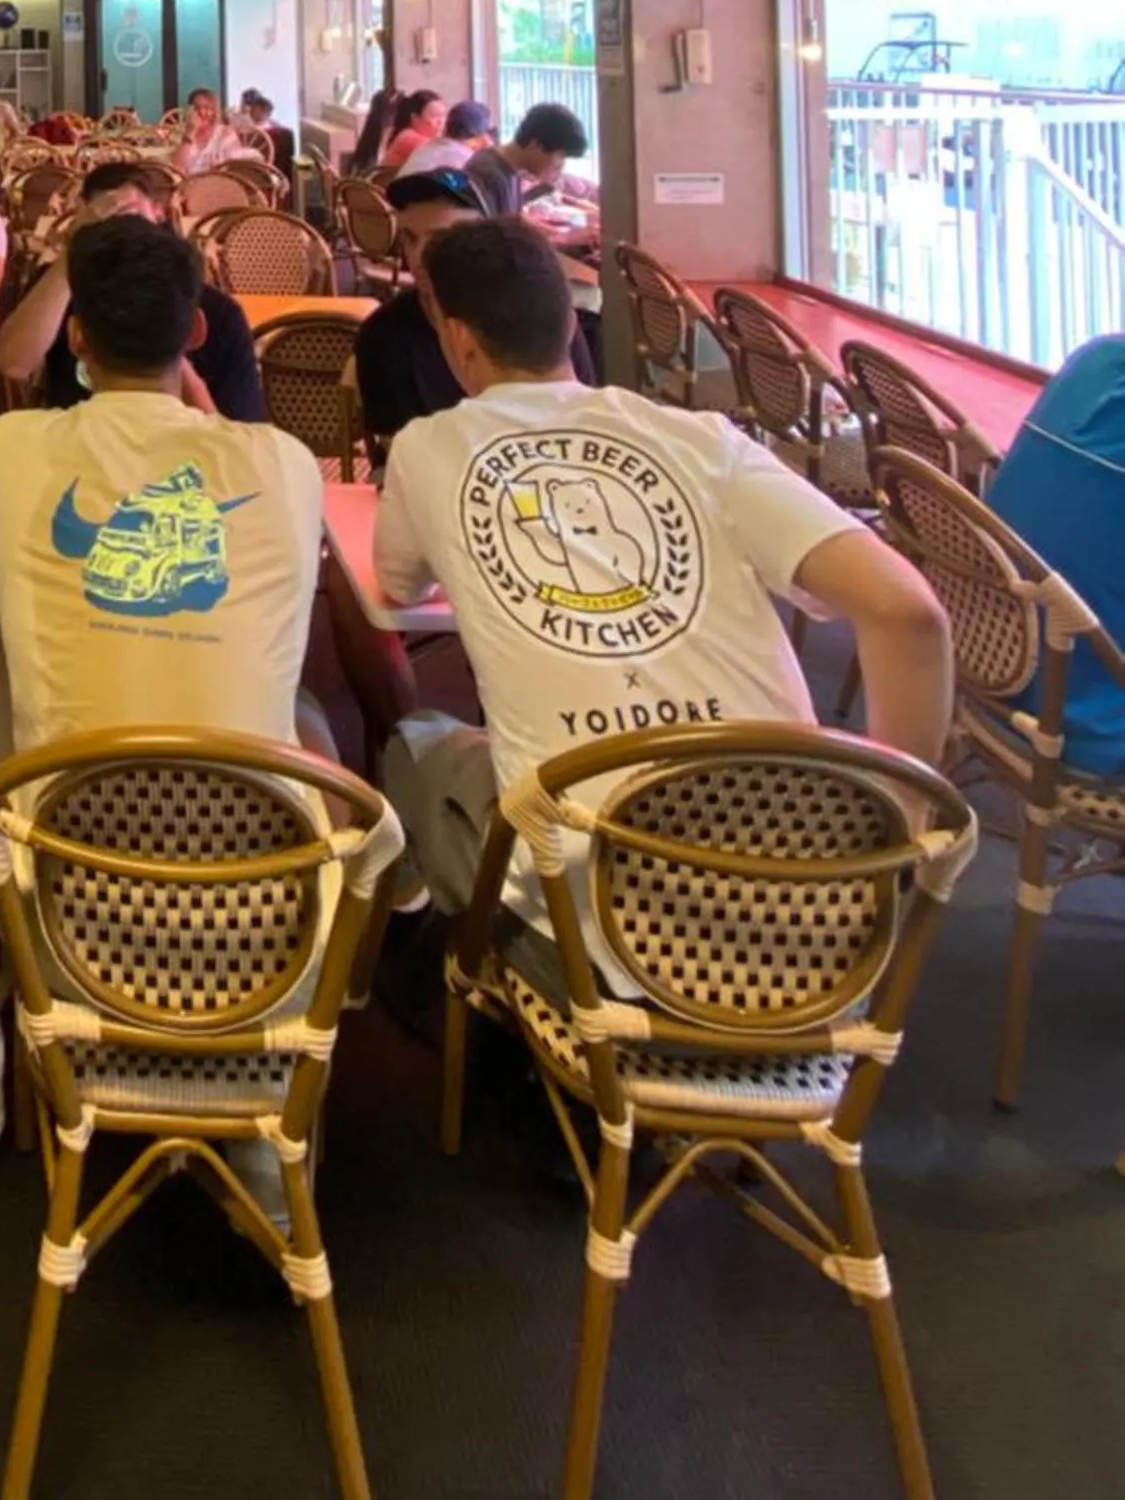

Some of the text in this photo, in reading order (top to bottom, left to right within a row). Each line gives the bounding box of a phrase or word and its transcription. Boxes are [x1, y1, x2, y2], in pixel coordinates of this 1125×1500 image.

[469, 438, 660, 507] PERFECT BEER
[540, 604, 679, 647] KITCHEN
[559, 698, 723, 736] YOIDORE
